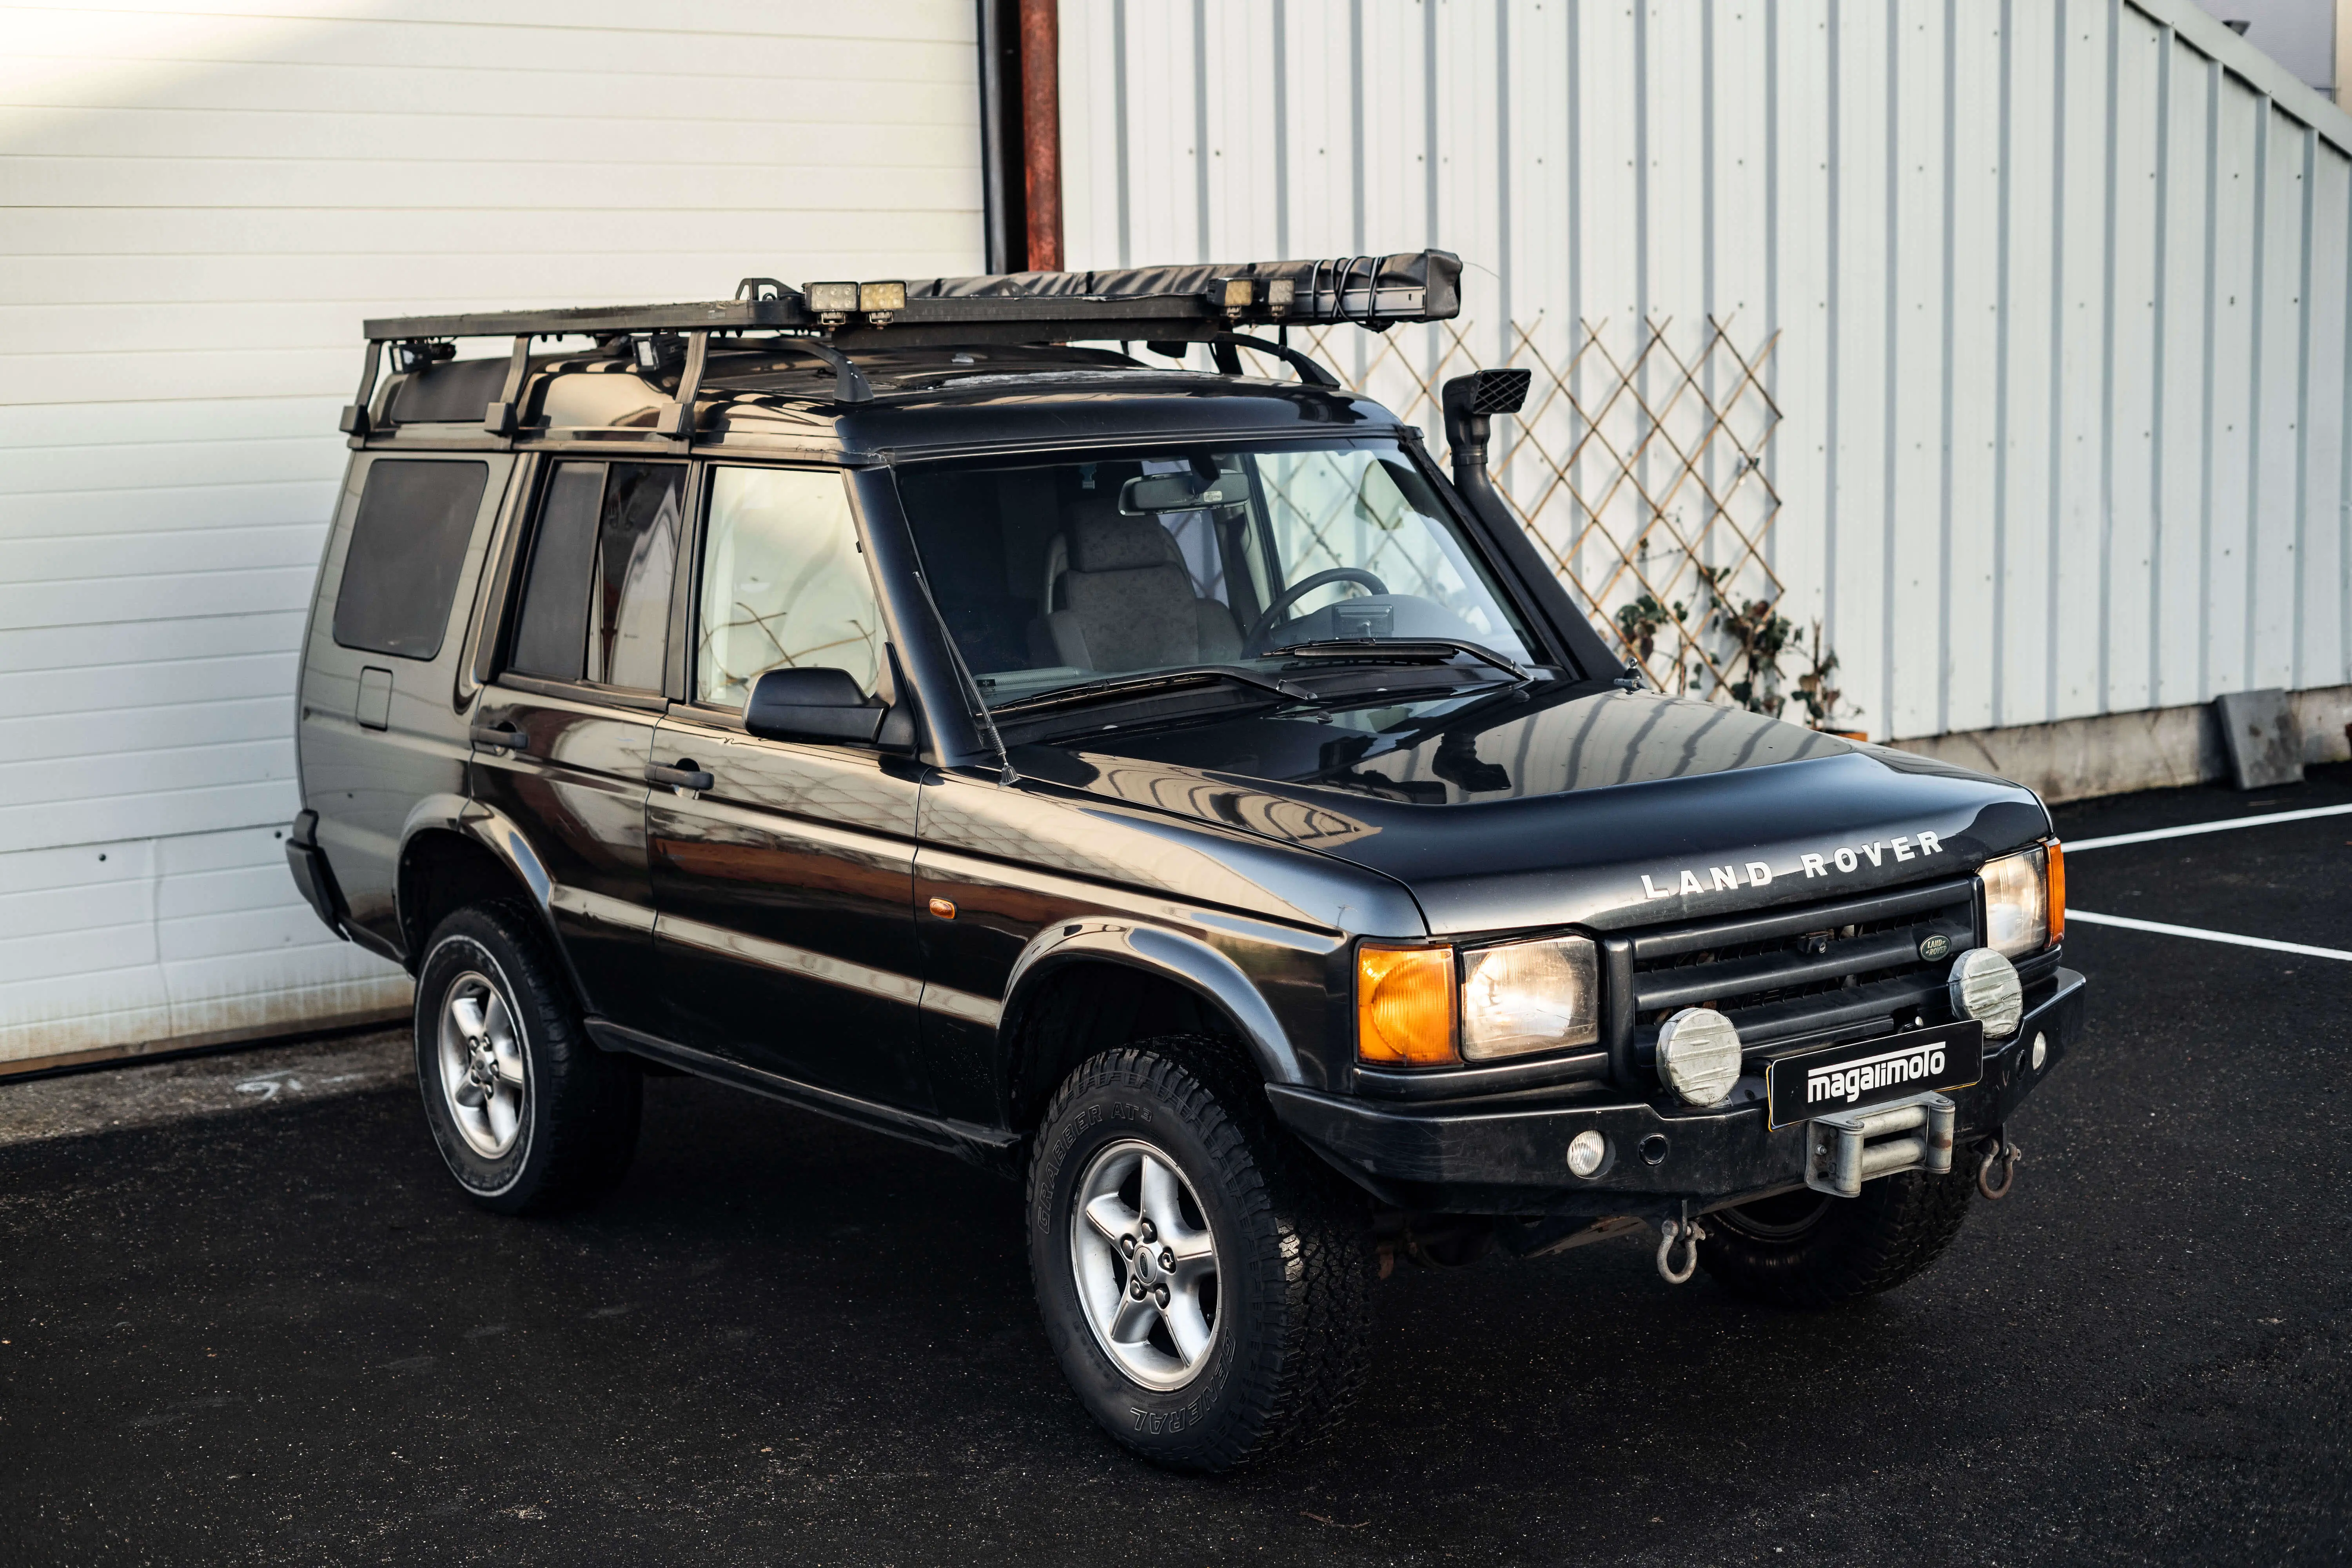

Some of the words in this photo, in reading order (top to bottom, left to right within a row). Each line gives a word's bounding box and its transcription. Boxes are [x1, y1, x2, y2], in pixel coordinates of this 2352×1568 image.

[1641, 861, 1773, 899] LAND
[1800, 830, 1943, 878] ROVER
[1927, 939, 1942, 948] LAND
[1929, 946, 1947, 955] ROVER
[1038, 1104, 1103, 1234] GRABBER
[1130, 1326, 1236, 1435] GENERAL
